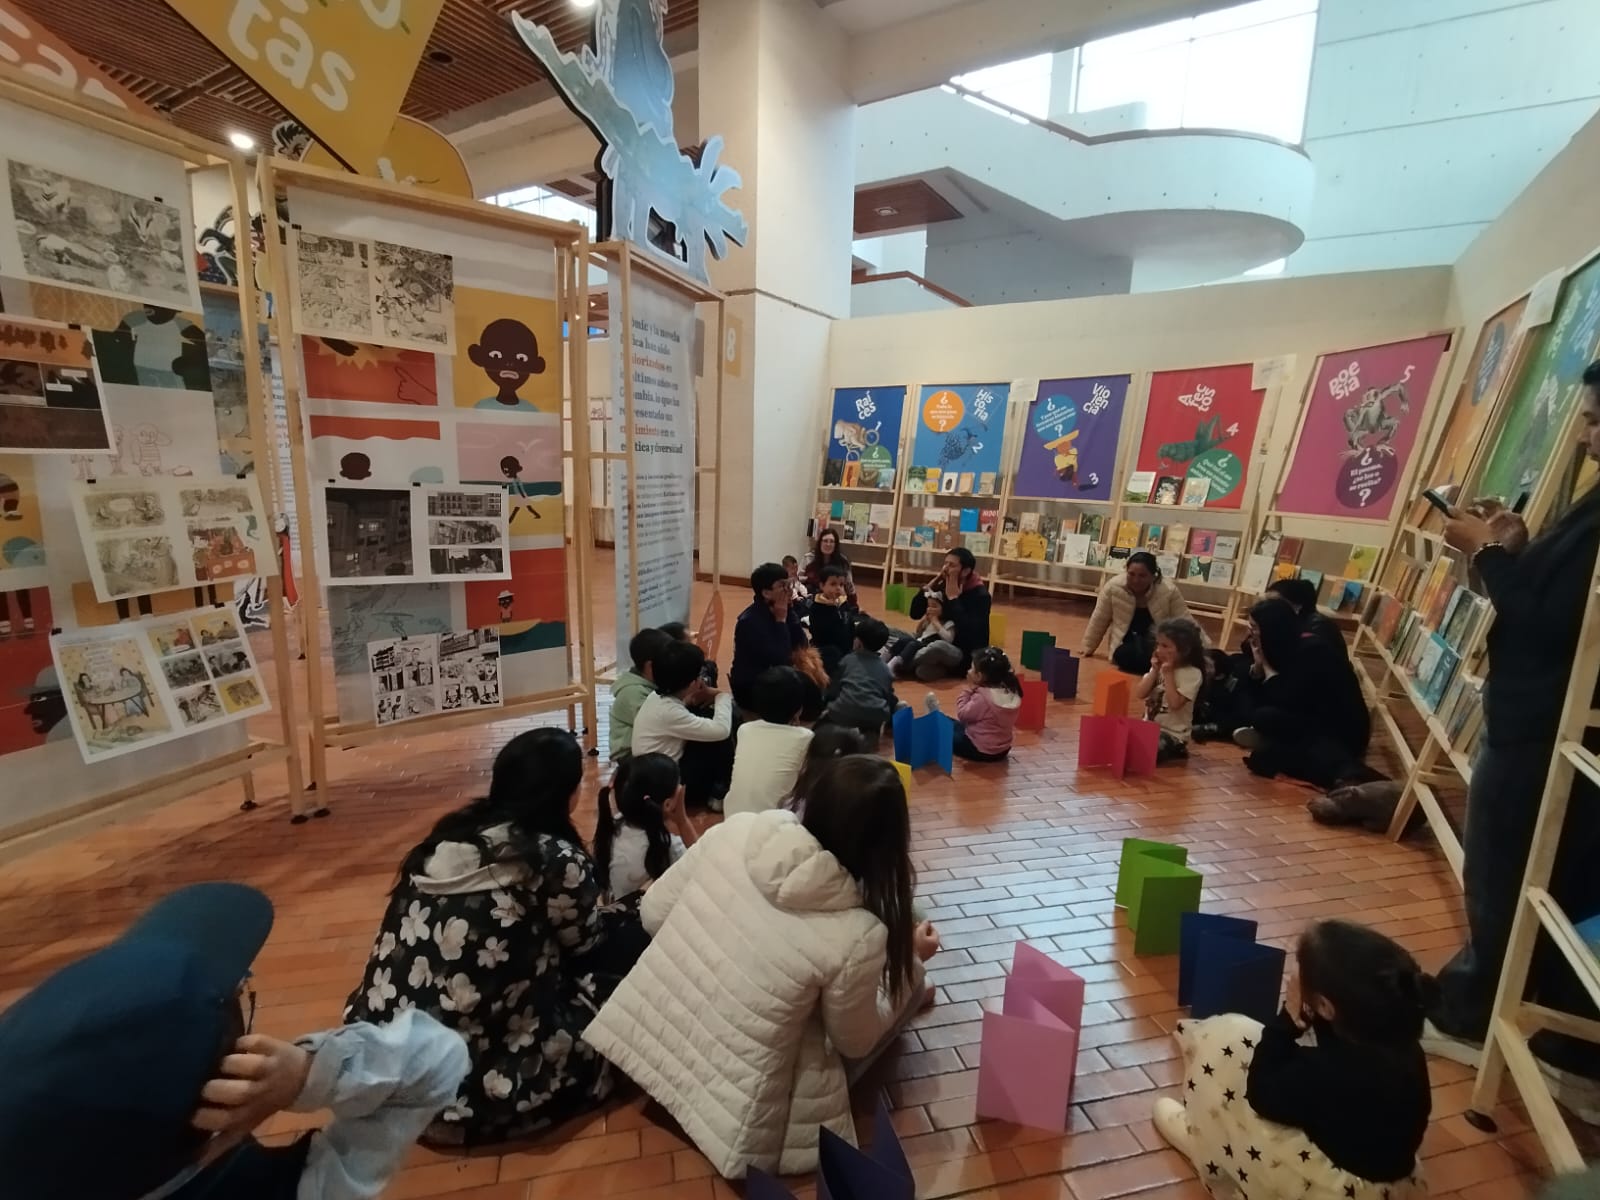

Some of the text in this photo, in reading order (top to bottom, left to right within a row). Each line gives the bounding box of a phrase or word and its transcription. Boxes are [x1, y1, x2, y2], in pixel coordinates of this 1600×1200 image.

[1400, 365, 1415, 383] 5
[1226, 422, 1239, 436] 4
[972, 441, 984, 454] 2
[1088, 472, 1099, 485] 3
